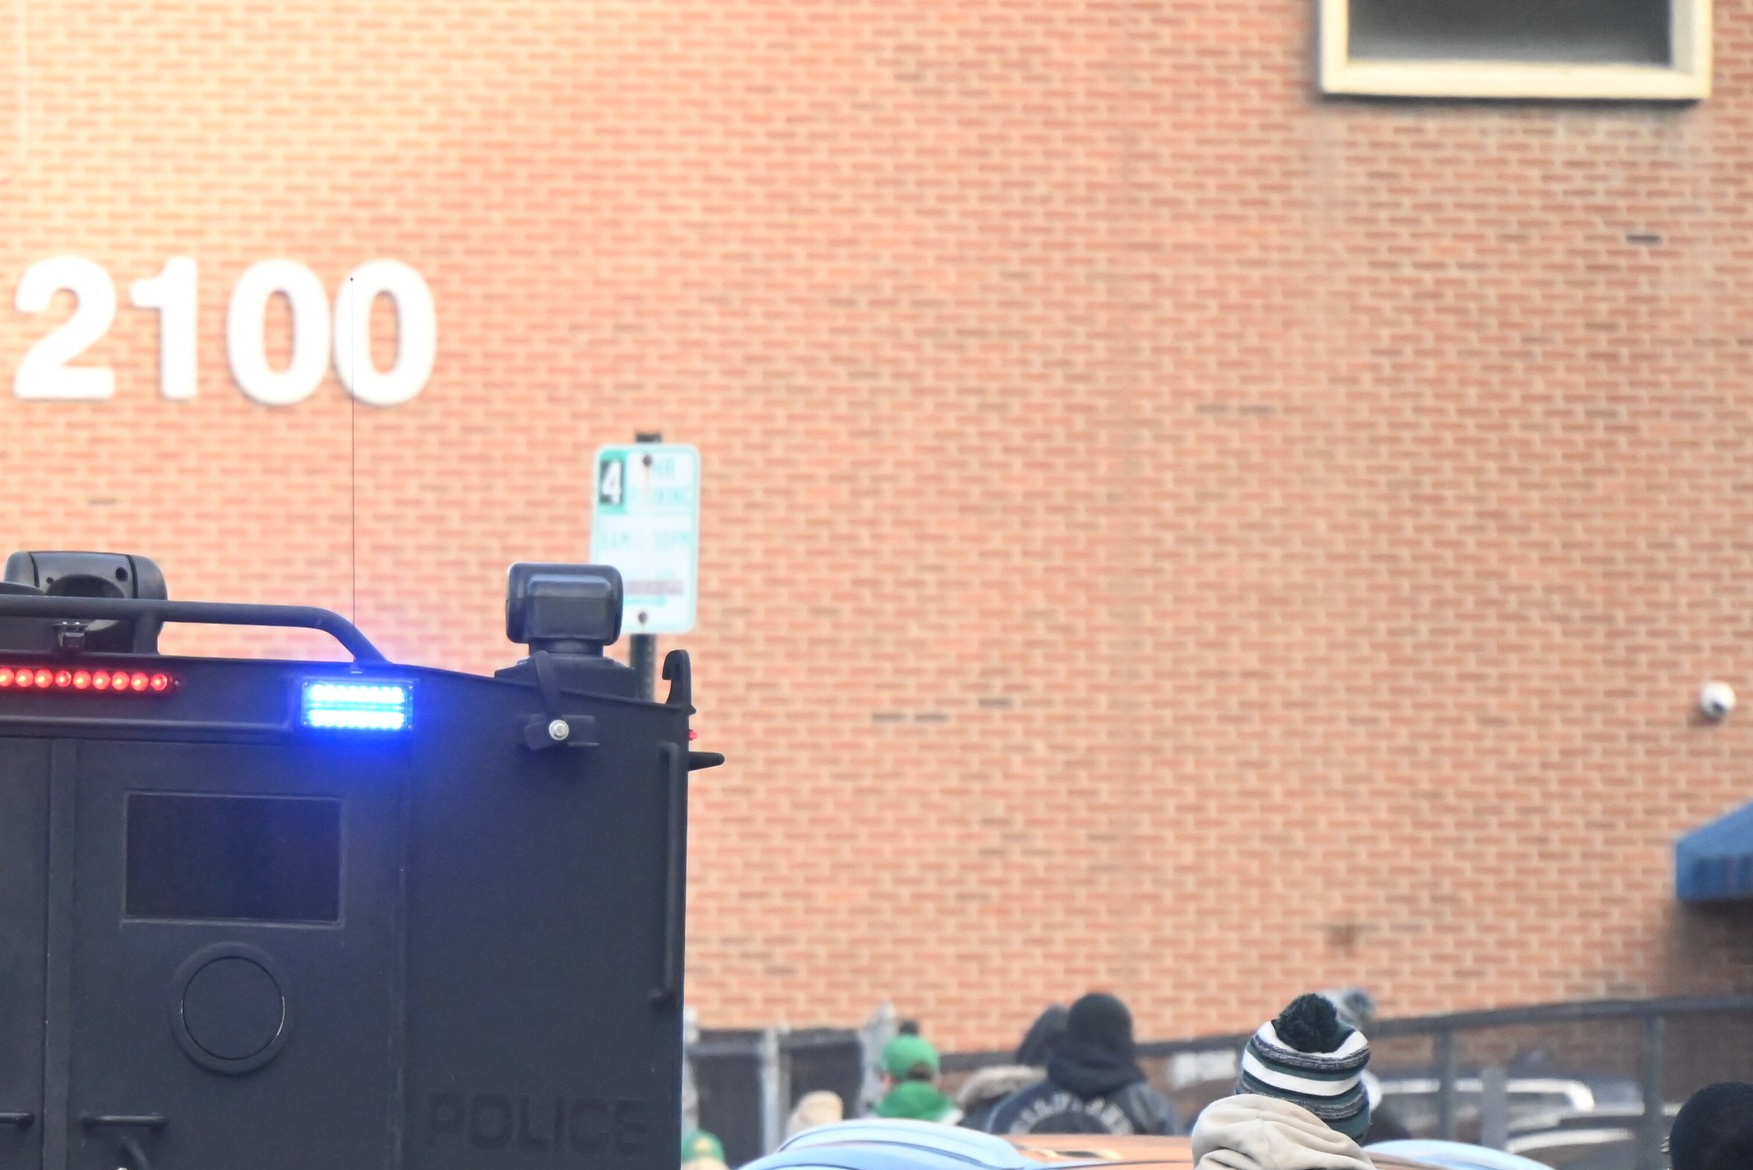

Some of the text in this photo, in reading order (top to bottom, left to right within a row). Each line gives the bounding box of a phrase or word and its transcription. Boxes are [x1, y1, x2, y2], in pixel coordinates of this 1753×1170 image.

[14, 255, 437, 406] 2100
[601, 460, 623, 505] 4
[428, 1091, 647, 1154] POLICE
